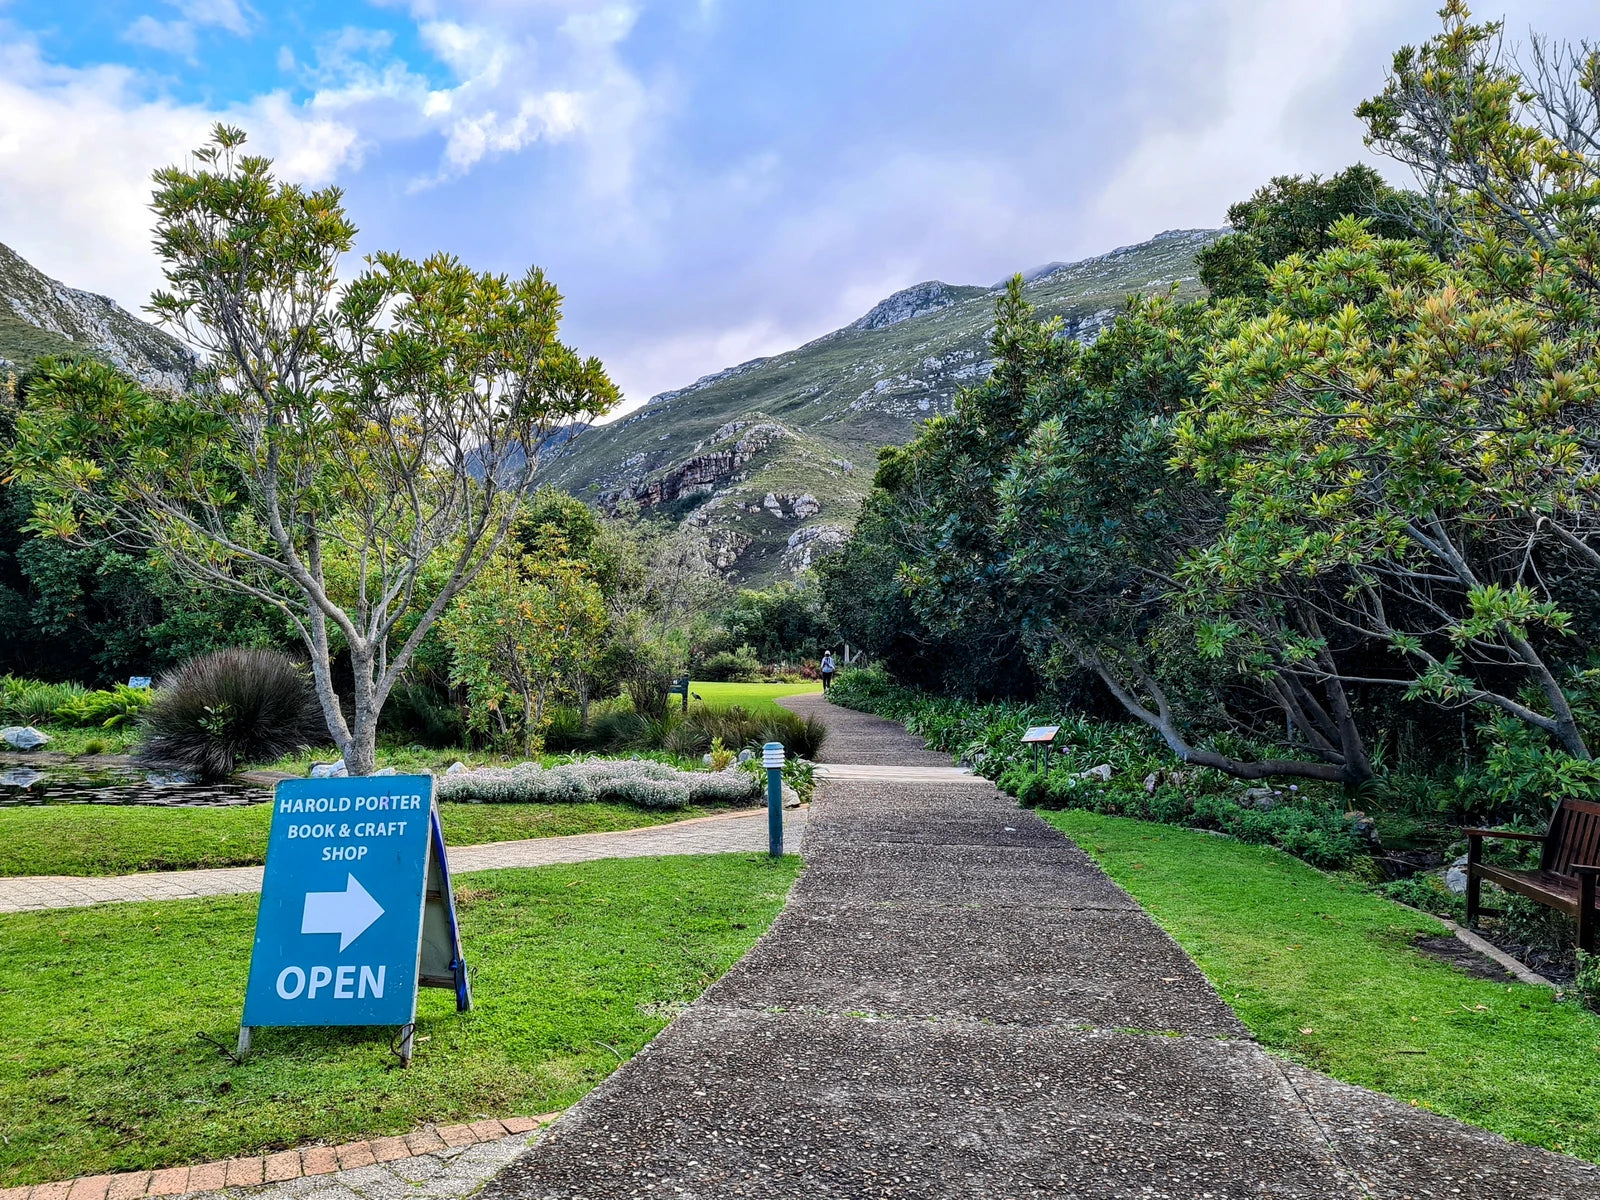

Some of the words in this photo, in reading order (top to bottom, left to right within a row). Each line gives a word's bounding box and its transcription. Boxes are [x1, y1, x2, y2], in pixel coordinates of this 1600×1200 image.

[279, 797, 351, 813] HAROLD
[354, 795, 421, 811] PORTER
[287, 823, 335, 838] BOOK
[338, 823, 351, 837] &
[354, 821, 407, 837] CRAFT
[321, 846, 368, 861] SHOP
[275, 965, 386, 1000] OPEN
